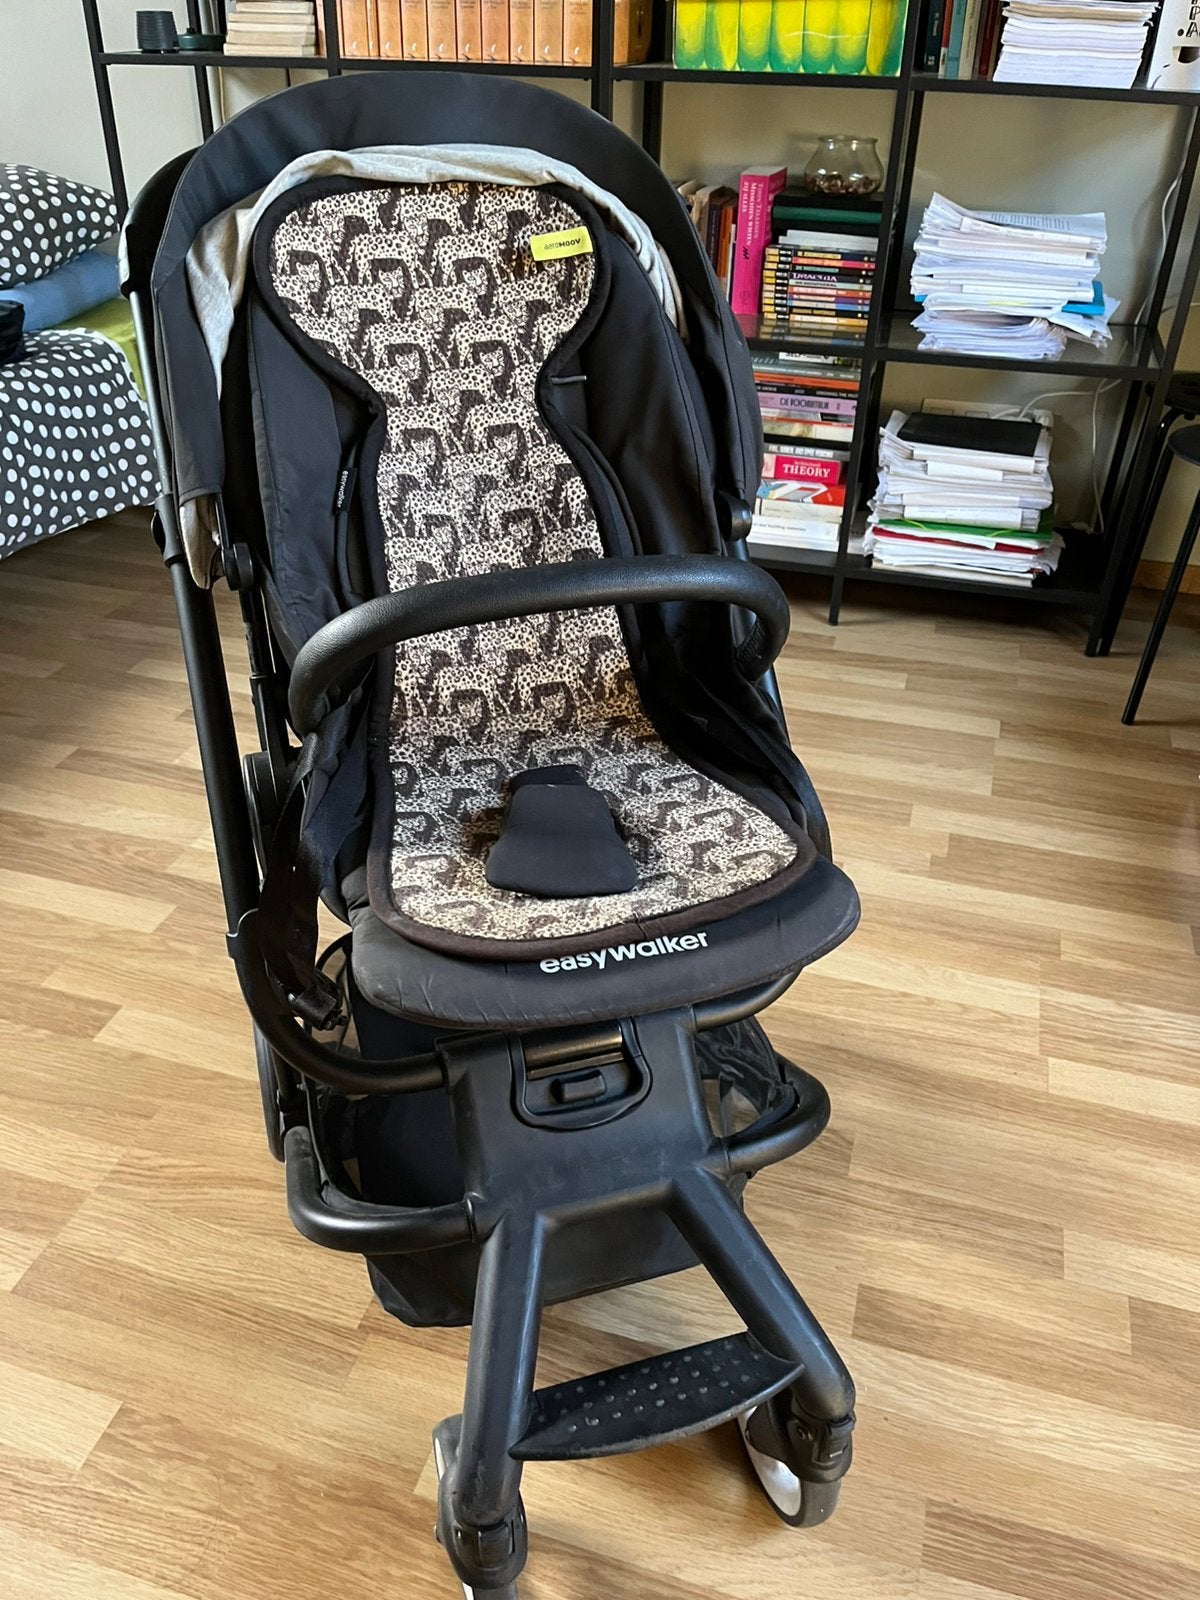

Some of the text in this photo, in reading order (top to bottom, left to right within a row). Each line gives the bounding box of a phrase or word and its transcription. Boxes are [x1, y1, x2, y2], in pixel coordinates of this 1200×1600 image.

[543, 238, 581, 250] aeroMOOV
[783, 464, 831, 478] THEORY
[337, 470, 349, 508] easywalker
[539, 931, 710, 974] easywalker
